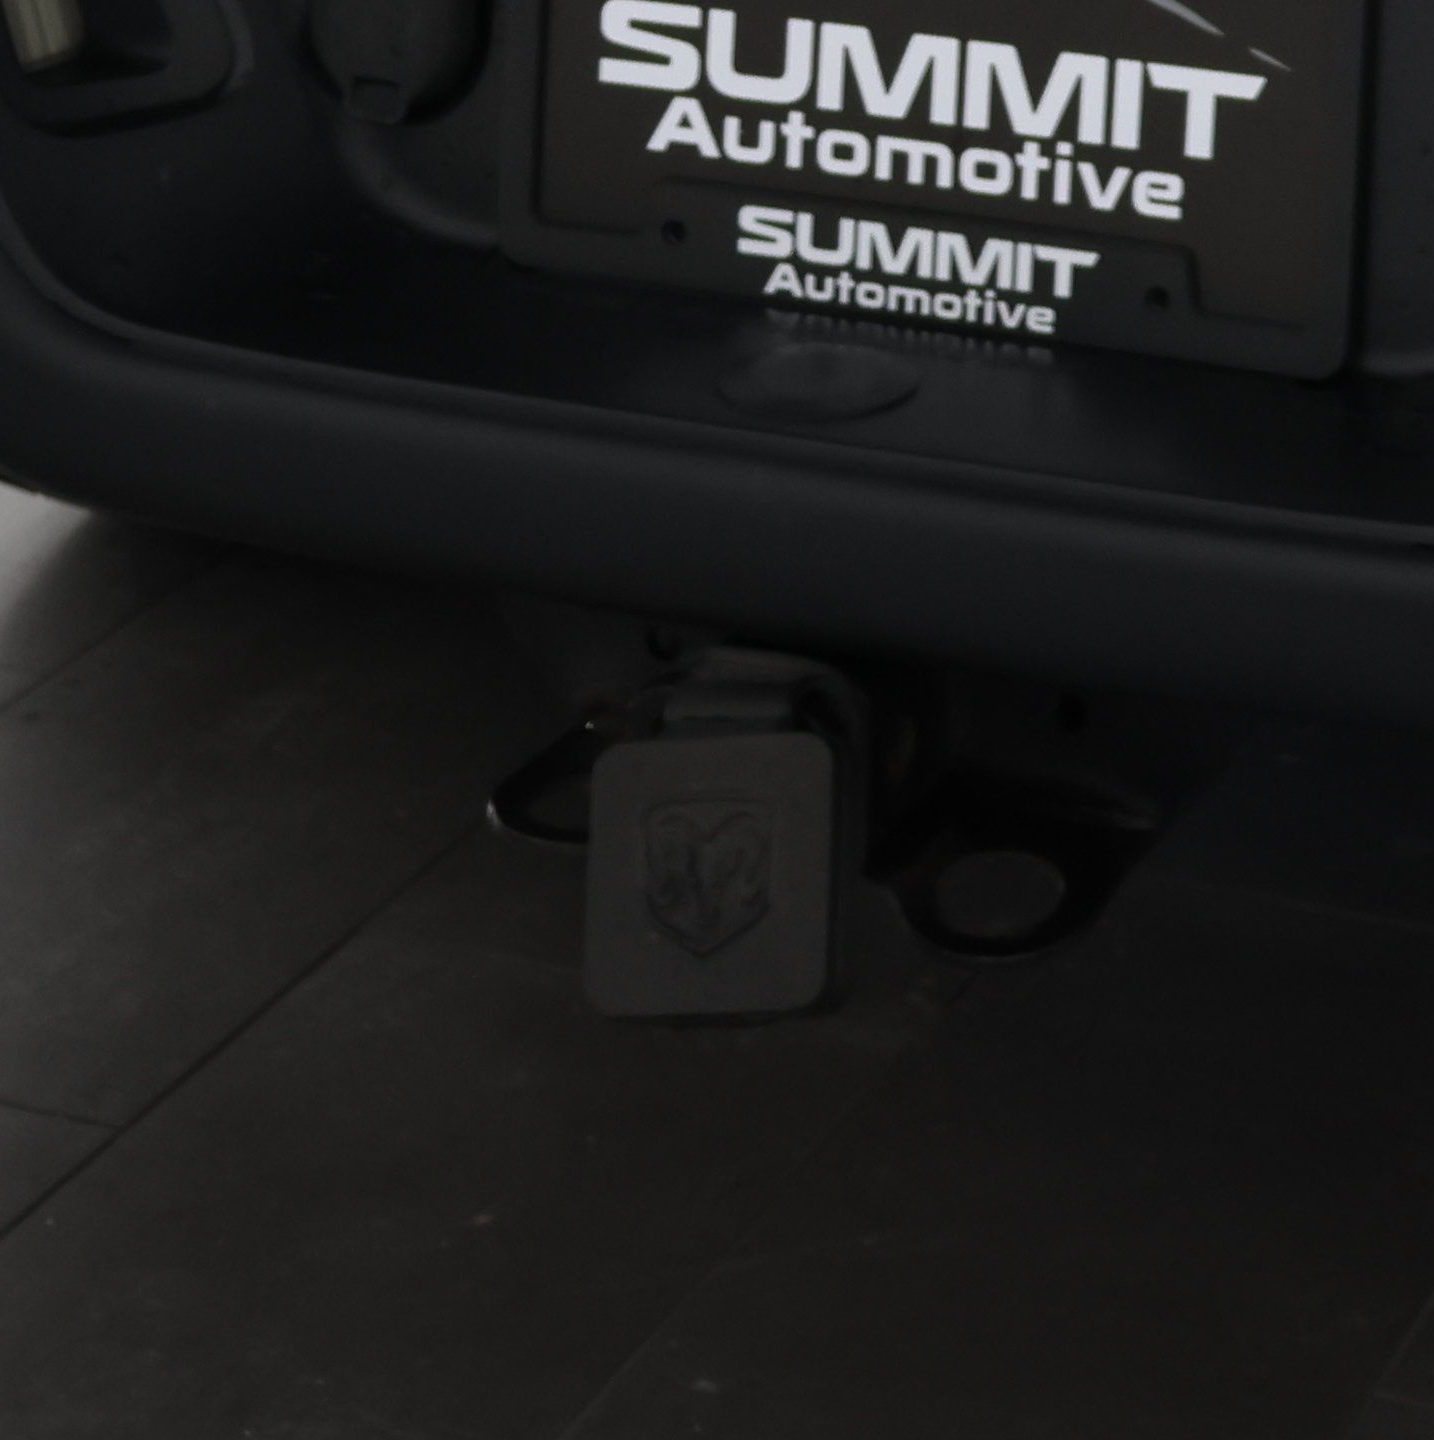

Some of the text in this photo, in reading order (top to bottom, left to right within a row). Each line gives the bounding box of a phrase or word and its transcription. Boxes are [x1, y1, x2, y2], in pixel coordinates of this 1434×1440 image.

[646, 96, 1185, 221] Automotive
[736, 205, 1100, 299] SUMMIT
[763, 262, 1057, 335] Automotive
